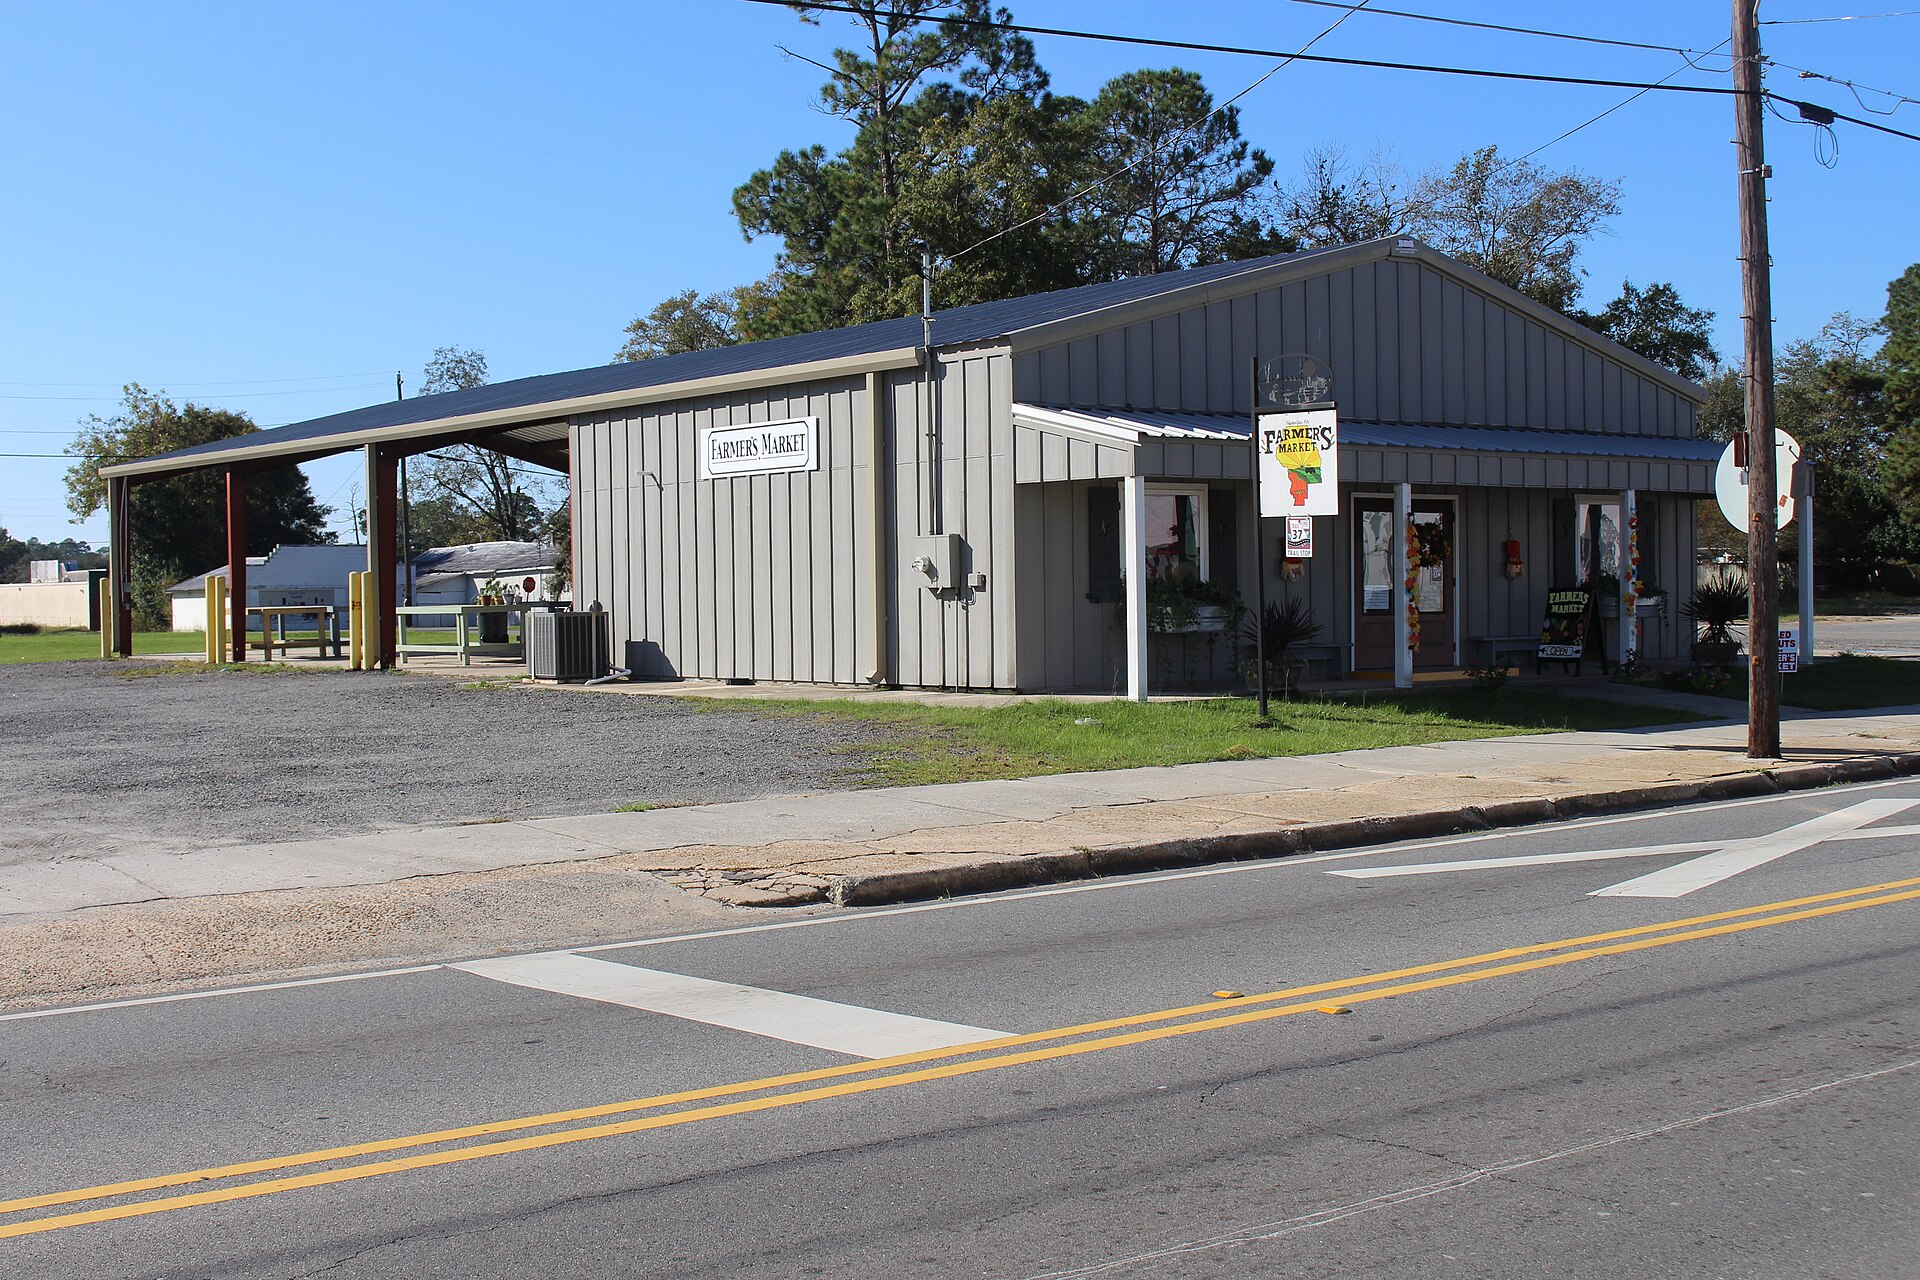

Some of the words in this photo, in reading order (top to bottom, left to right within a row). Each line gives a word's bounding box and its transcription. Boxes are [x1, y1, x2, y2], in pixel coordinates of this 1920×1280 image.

[1264, 425, 1332, 454] FARMER'S
[711, 436, 758, 460] FARMER'S
[761, 433, 806, 455] MARKET
[1278, 442, 1317, 453] MARKET
[1292, 529, 1303, 540] 37
[1551, 604, 1585, 613] MARKET
[1550, 646, 1569, 656] OPEN
